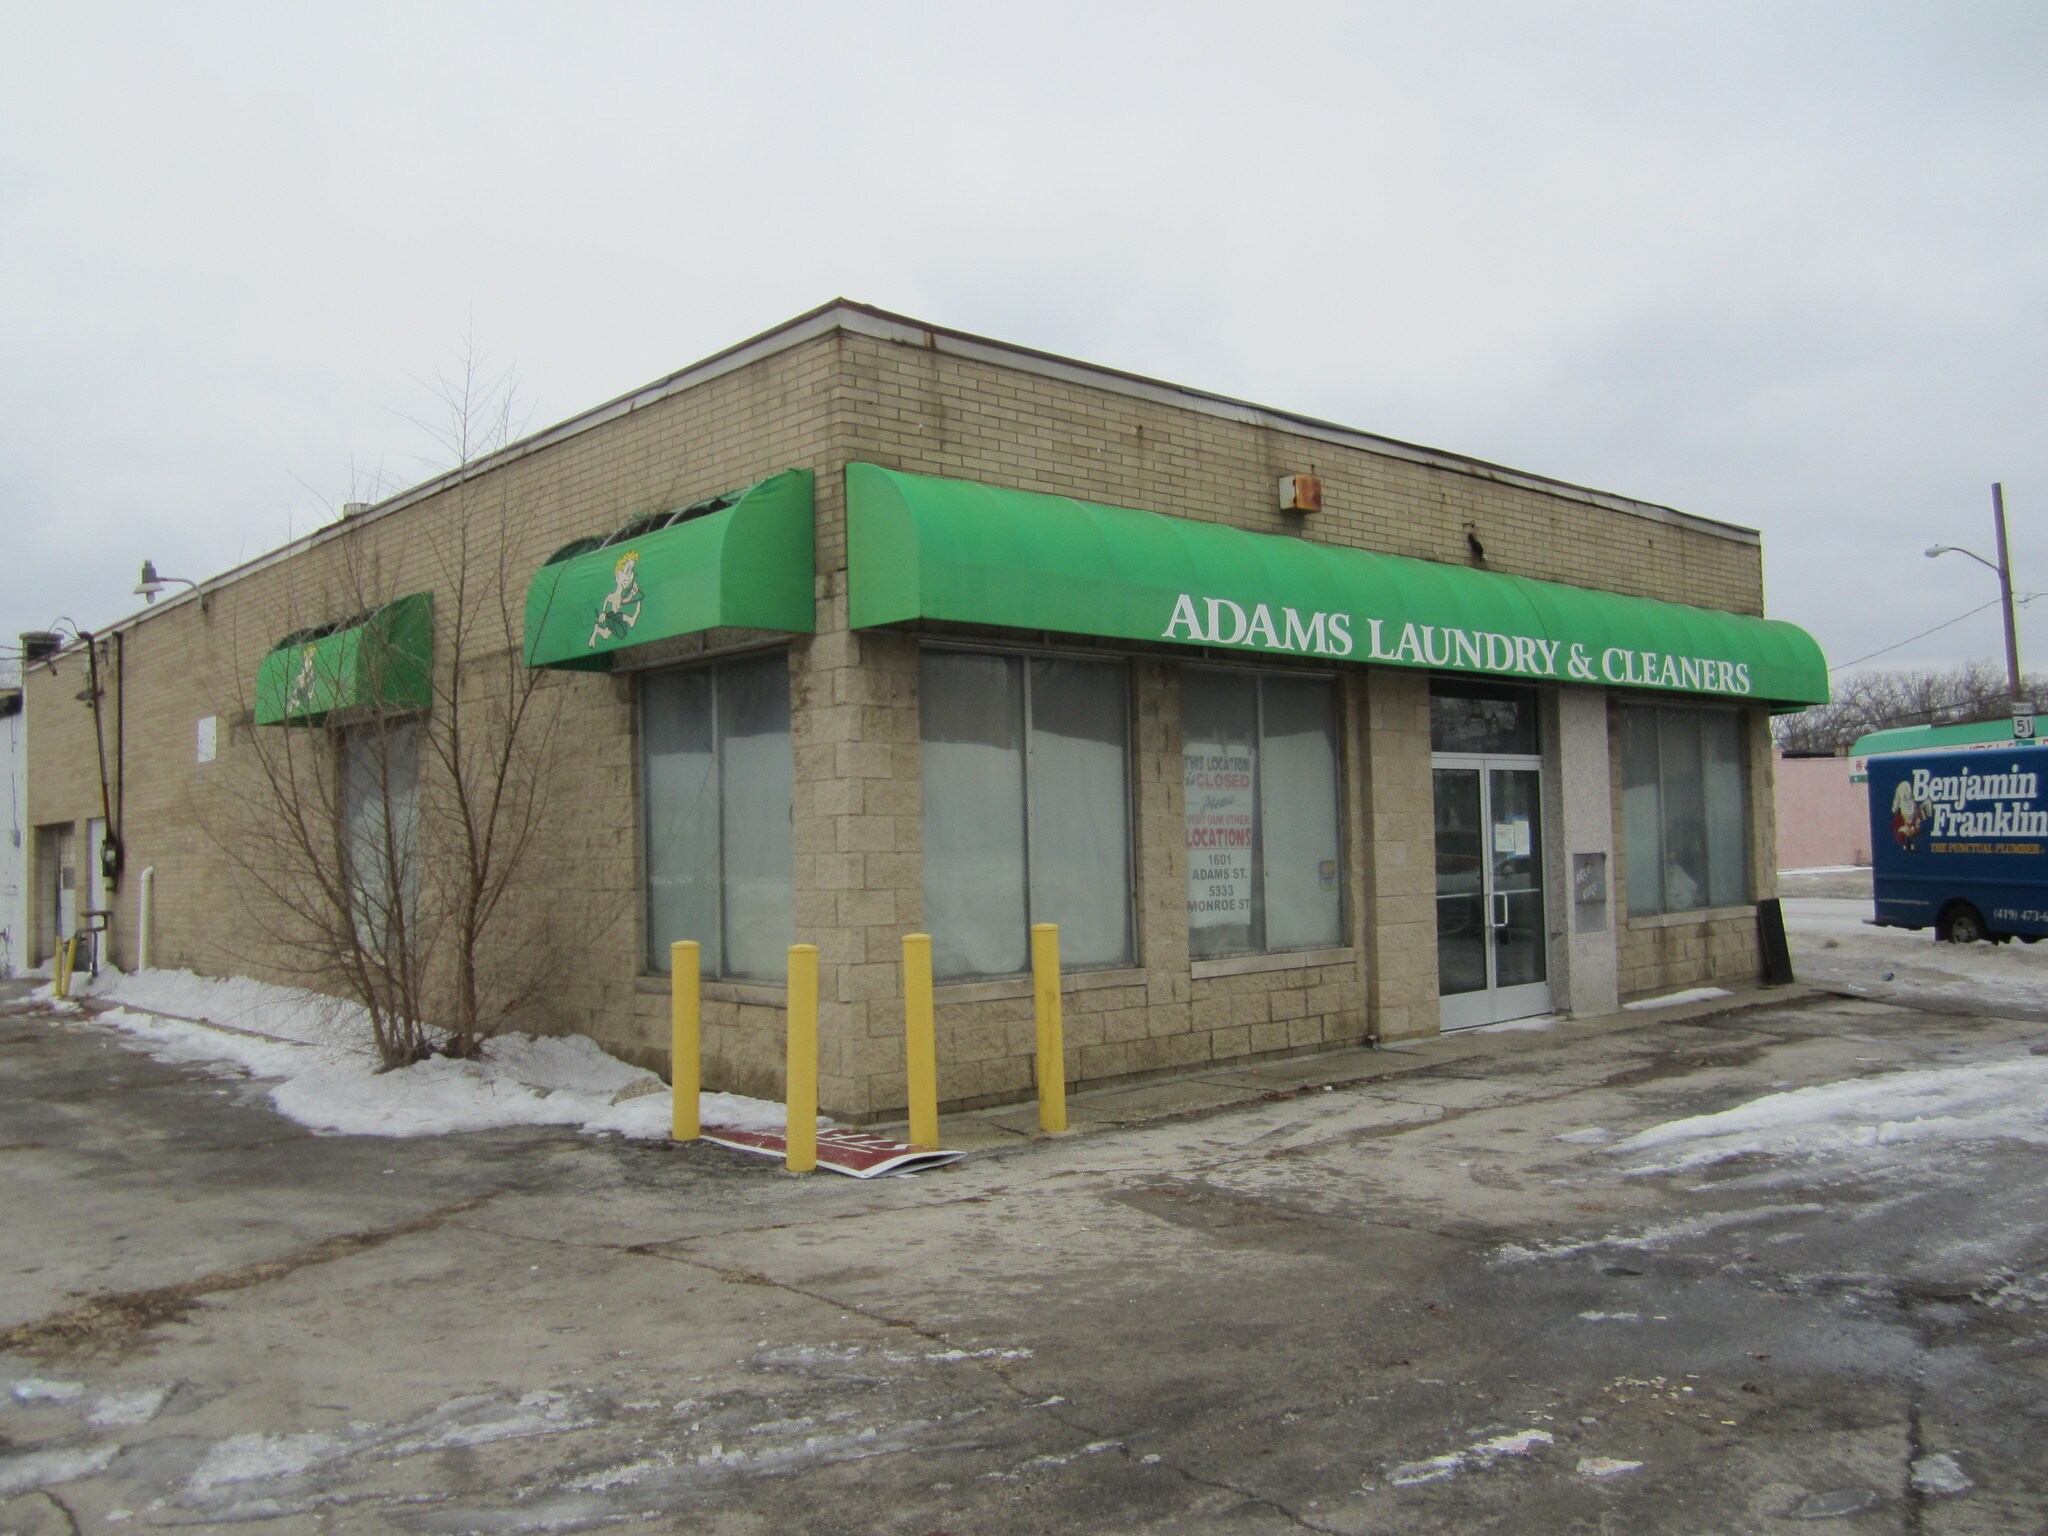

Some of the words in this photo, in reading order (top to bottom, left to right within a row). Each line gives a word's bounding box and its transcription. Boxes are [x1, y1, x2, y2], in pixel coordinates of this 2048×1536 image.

[1161, 593, 1353, 656] ADAMS
[1367, 617, 1560, 676] LAUNDRY
[1567, 642, 1598, 680] &
[1601, 647, 1750, 695] CLEANERS
[2016, 719, 2031, 733] 51
[1185, 755, 1204, 771] THIS
[1207, 756, 1249, 772] LOCATION
[1196, 773, 1250, 788] CLOSED
[1912, 764, 2037, 810] Benjamin
[1207, 815, 1224, 826] OUR
[1225, 815, 1250, 826] OTHER
[1930, 802, 2048, 837] Franklin
[1186, 827, 1251, 848] LOCATIONS
[1931, 843, 1946, 853] THE
[1208, 854, 1232, 866] 1601
[1192, 868, 1230, 881] ADAMS
[1233, 867, 1248, 879] ST.
[1209, 885, 1234, 897] 5333
[1187, 899, 1235, 912] MONROE
[1994, 908, 2017, 920] (419)
